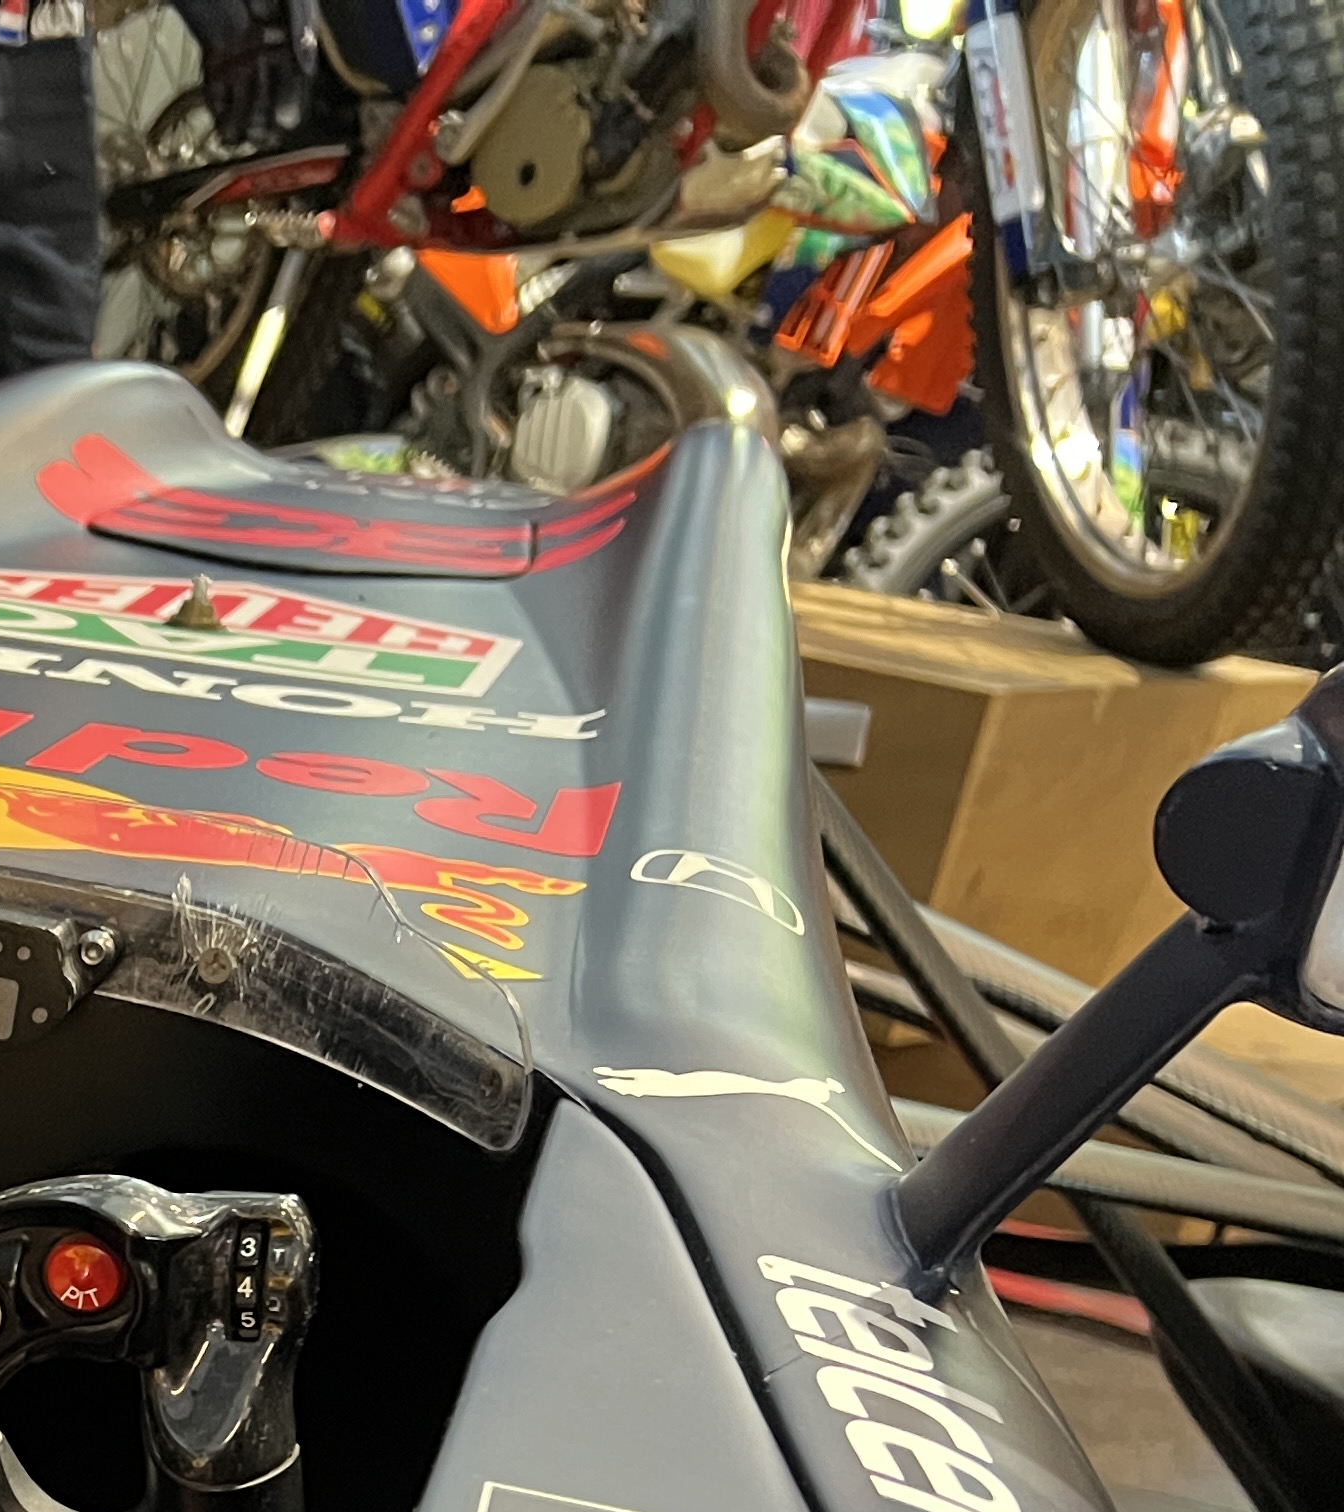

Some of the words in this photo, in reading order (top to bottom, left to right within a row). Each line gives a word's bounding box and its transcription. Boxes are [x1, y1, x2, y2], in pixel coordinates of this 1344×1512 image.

[26, 722, 622, 857] Red
[240, 1237, 256, 1257] 3
[60, 1285, 99, 1310] PIT
[237, 1276, 253, 1298] 4
[240, 1311, 256, 1328] 5
